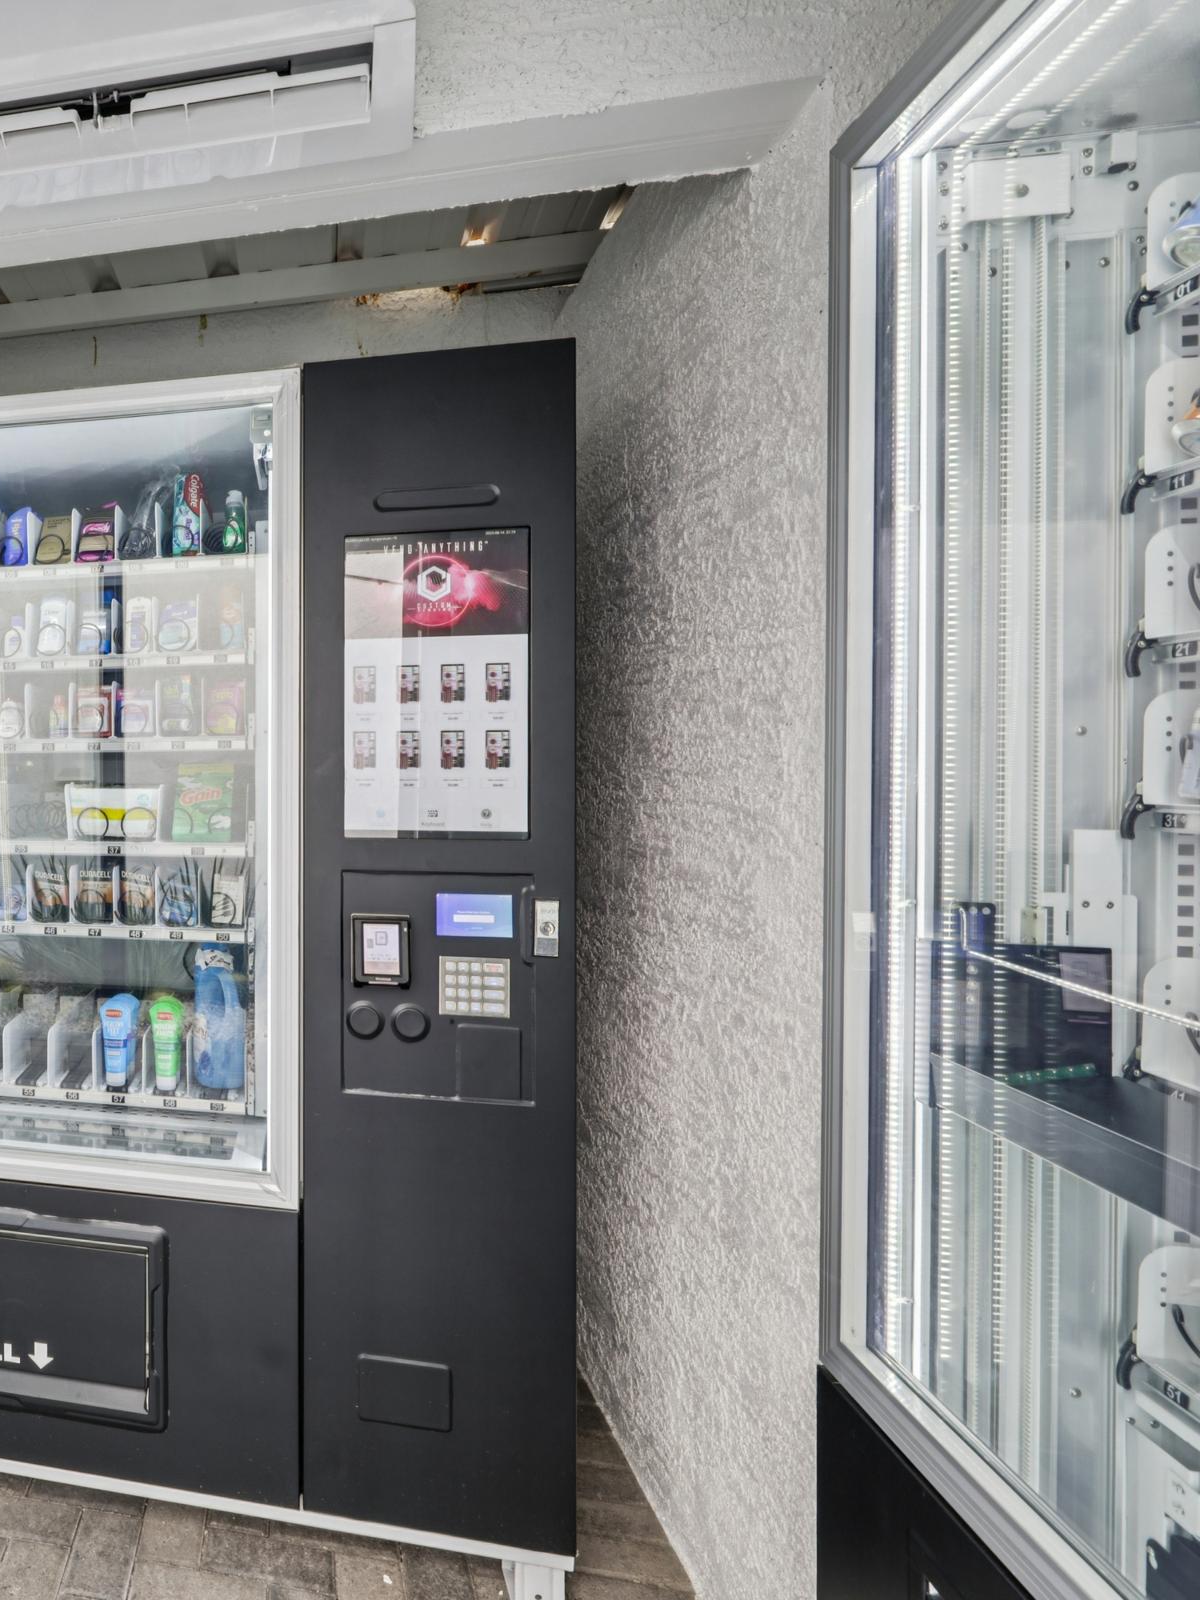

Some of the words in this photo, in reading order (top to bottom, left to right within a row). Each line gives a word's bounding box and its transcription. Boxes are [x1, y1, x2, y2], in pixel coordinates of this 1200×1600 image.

[1176, 280, 1192, 298] 01
[1172, 474, 1186, 487] 11
[188, 473, 201, 508] Colgate
[1175, 643, 1190, 657] 21
[173, 787, 222, 806] Gain
[1163, 815, 1178, 828] 31
[79, 869, 111, 879] DURACELL
[1166, 1384, 1182, 1404] 51
